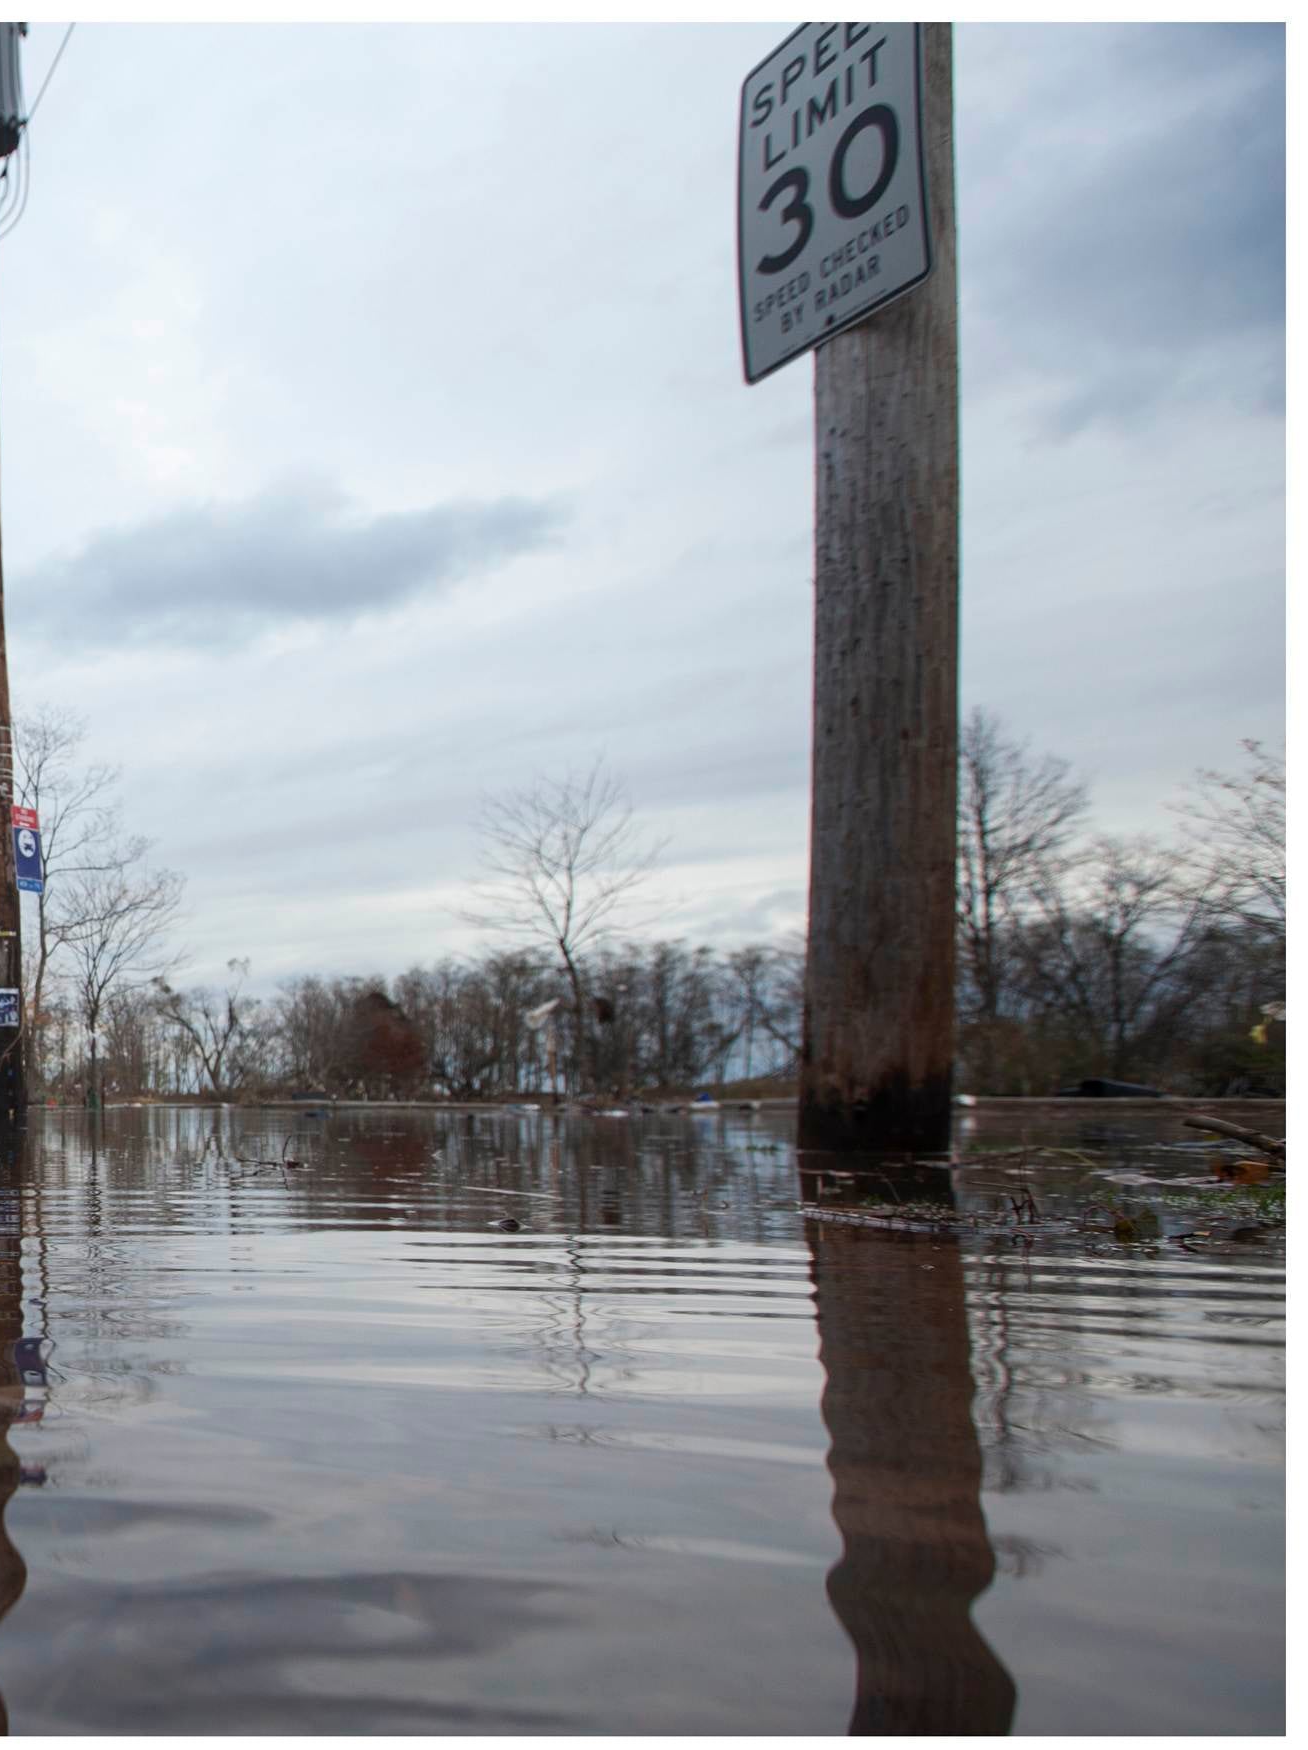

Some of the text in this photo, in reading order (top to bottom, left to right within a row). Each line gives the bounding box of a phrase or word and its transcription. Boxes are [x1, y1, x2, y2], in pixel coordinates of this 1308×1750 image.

[750, 22, 872, 129] SPEE
[764, 37, 887, 172] LIMIT
[757, 103, 899, 275] 30
[754, 271, 811, 323] SPEED
[819, 204, 910, 279] CHECKED
[780, 307, 804, 335] BY
[814, 254, 881, 313] RADAR
